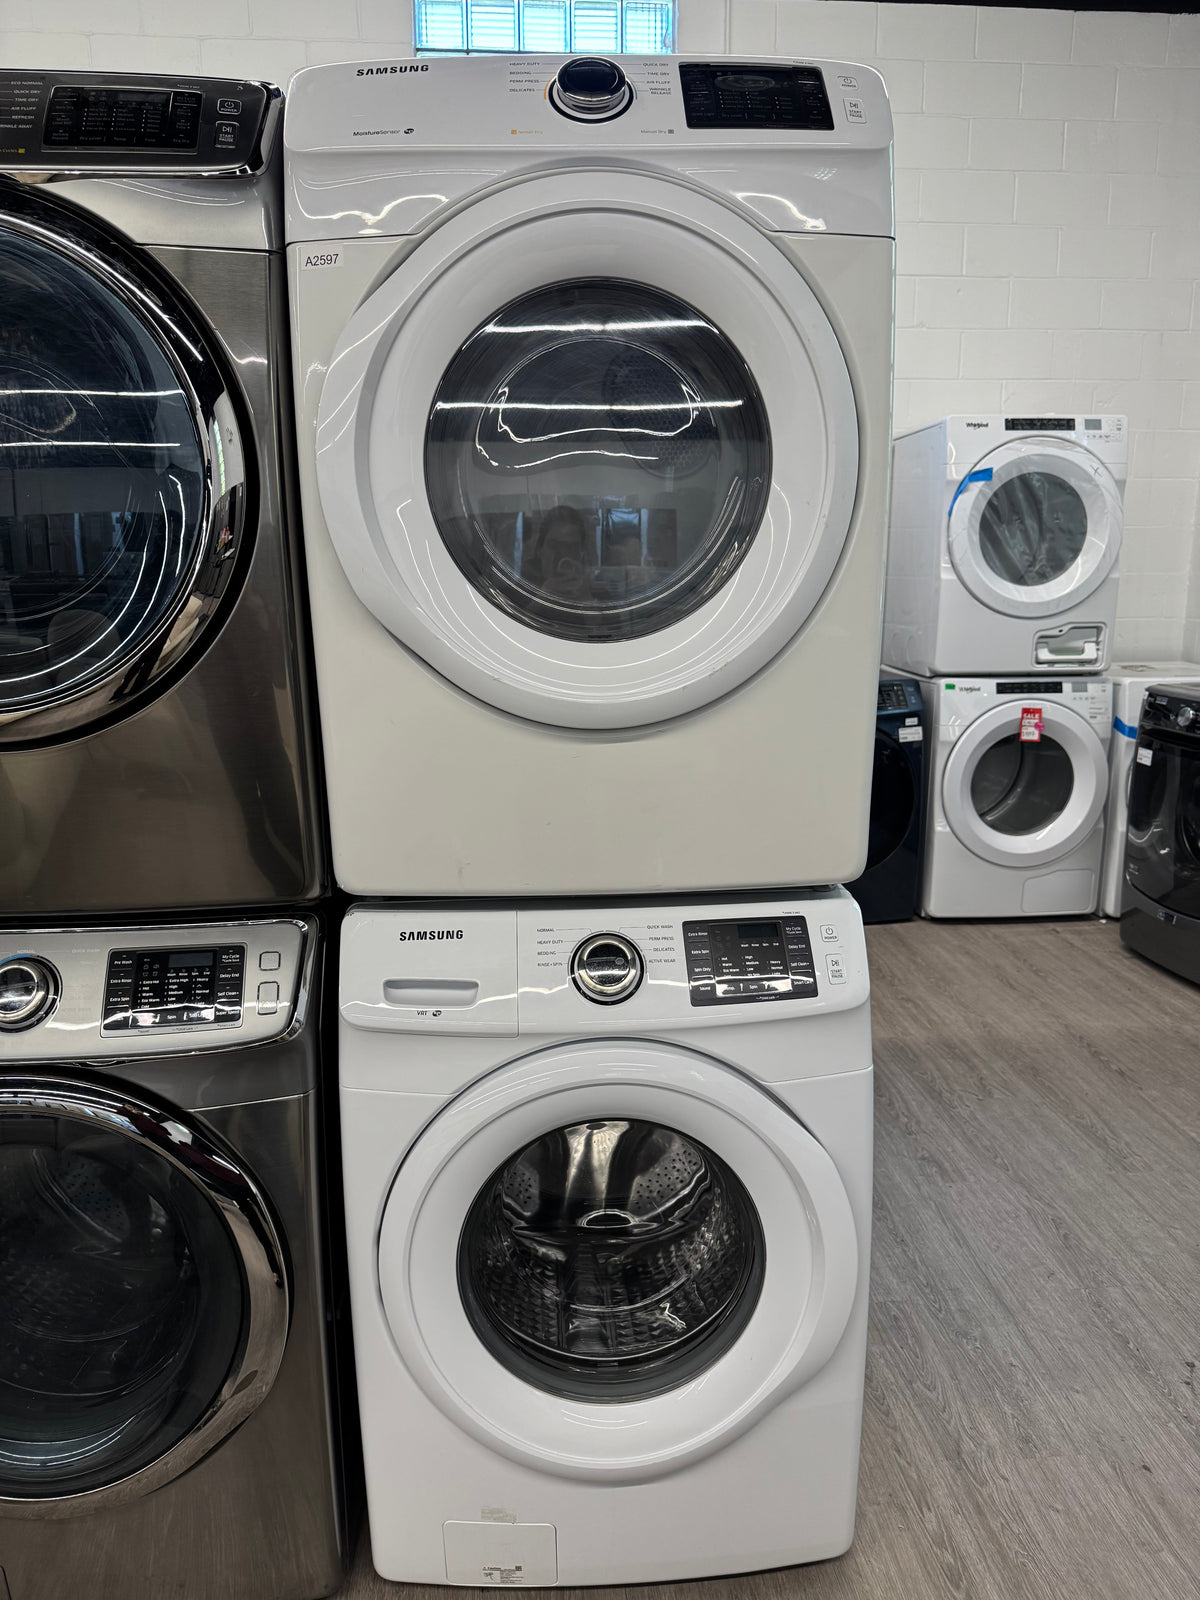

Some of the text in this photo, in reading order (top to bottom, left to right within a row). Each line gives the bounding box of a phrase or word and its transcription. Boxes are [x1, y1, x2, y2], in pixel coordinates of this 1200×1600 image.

[356, 64, 429, 77] SAMSUNG
[305, 253, 339, 267] A2597
[966, 422, 989, 430] Whirlpool
[959, 686, 981, 694] Whirlpool
[399, 929, 464, 942] SAMSUNG
